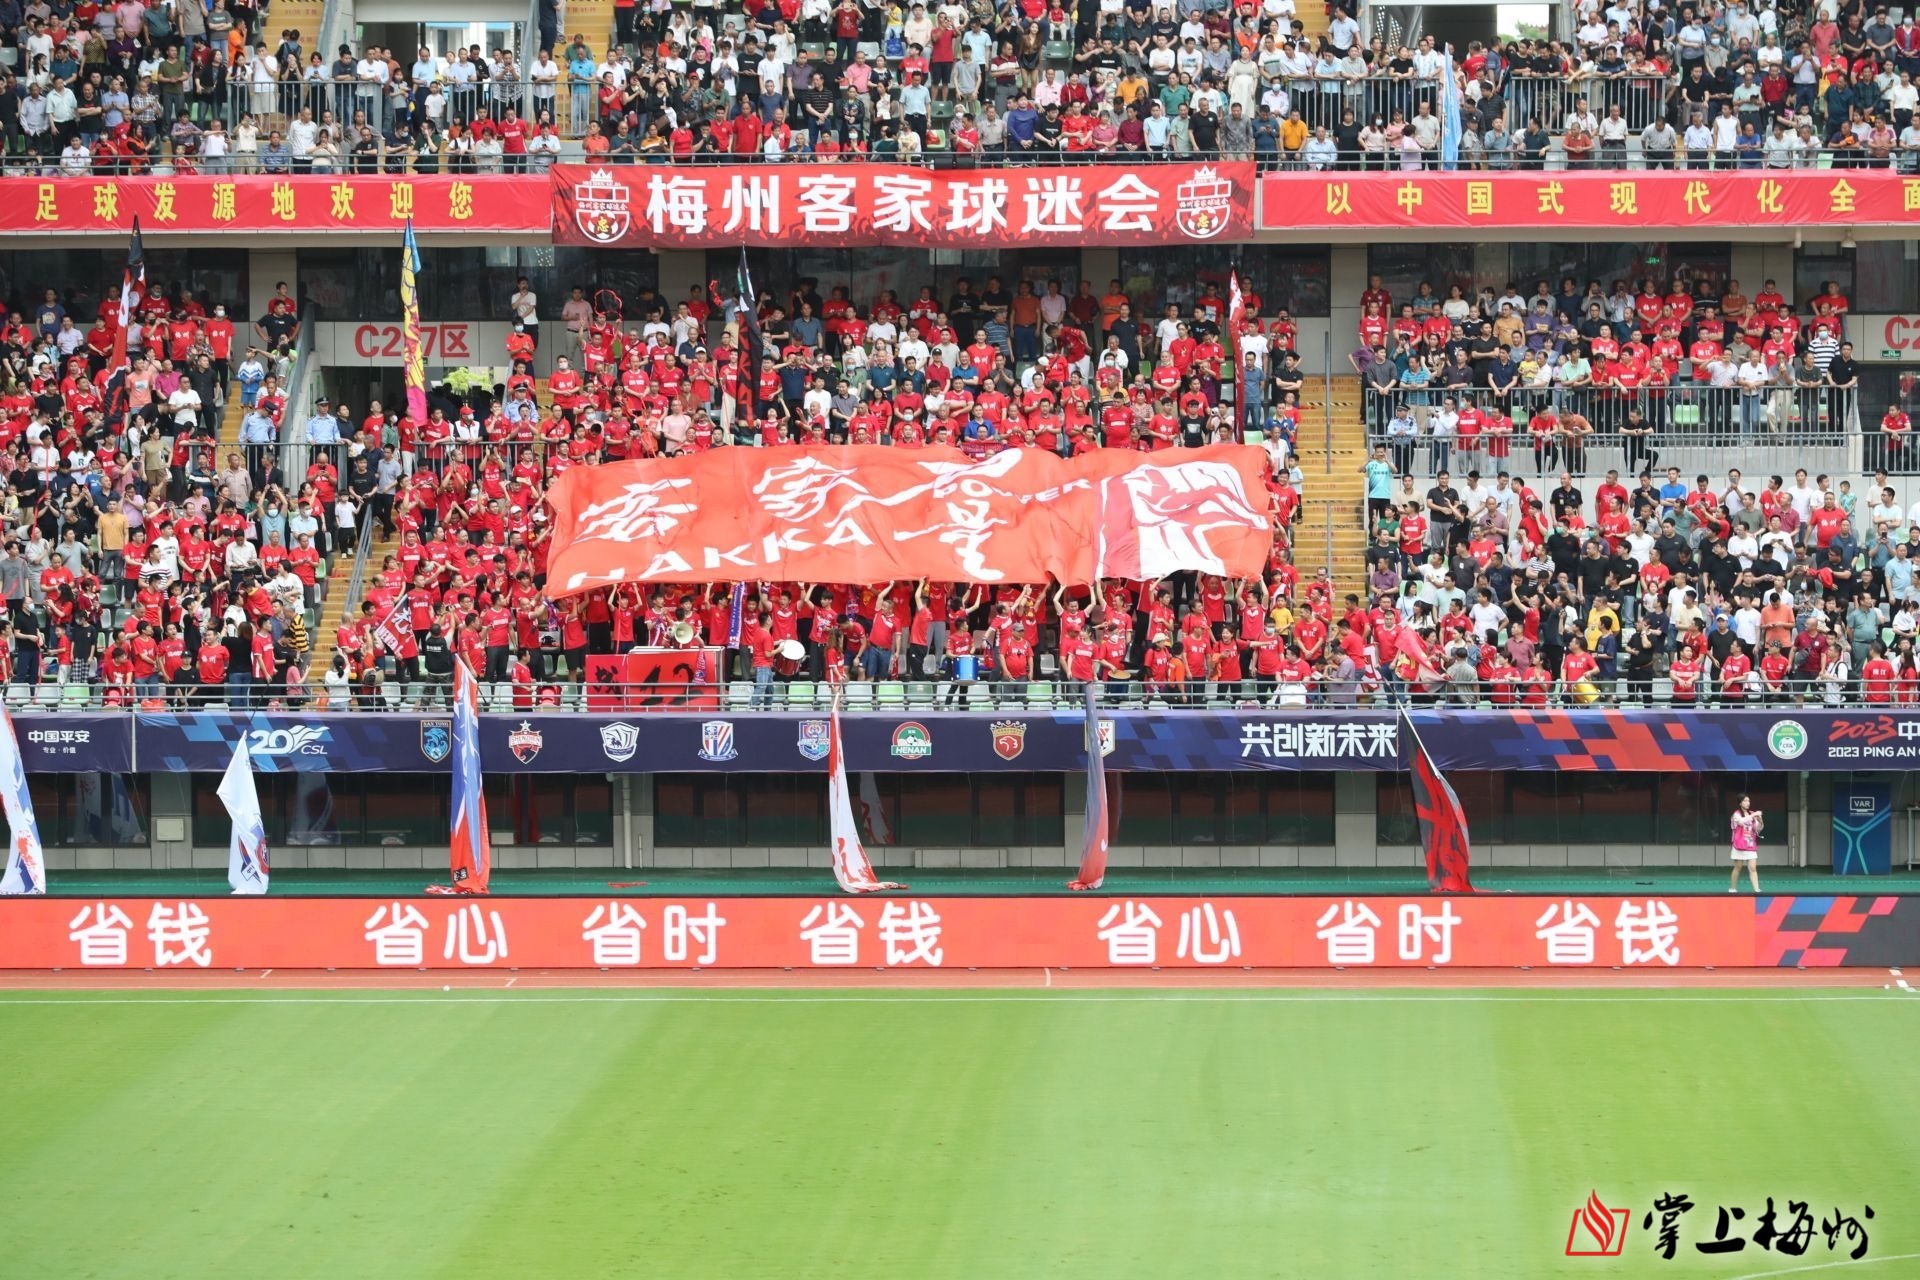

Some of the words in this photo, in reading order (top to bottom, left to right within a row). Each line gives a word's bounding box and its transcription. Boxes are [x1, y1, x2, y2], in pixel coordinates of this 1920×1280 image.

[35, 181, 473, 222] 足球发源地欢迎您
[646, 173, 1160, 234] 梅州客家球迷会
[1326, 179, 1920, 216] 以中国式现代化全面
[354, 324, 470, 358] C27区
[28, 730, 90, 743] 中国平安
[301, 744, 328, 755] CSL
[895, 746, 928, 755] HENAN
[1239, 722, 1397, 757] 共创新未来
[1828, 746, 1860, 758] 2023
[1863, 746, 1895, 758] PING
[1896, 746, 1916, 758] AN
[1854, 800, 1871, 808] VAR
[70, 902, 212, 966] 省钱
[364, 902, 508, 965] 省心
[583, 902, 726, 965] 省时
[800, 901, 944, 966] 省钱
[1097, 901, 1241, 964] 省心
[1316, 901, 1461, 964] 省时
[1535, 900, 1681, 966] 省钱
